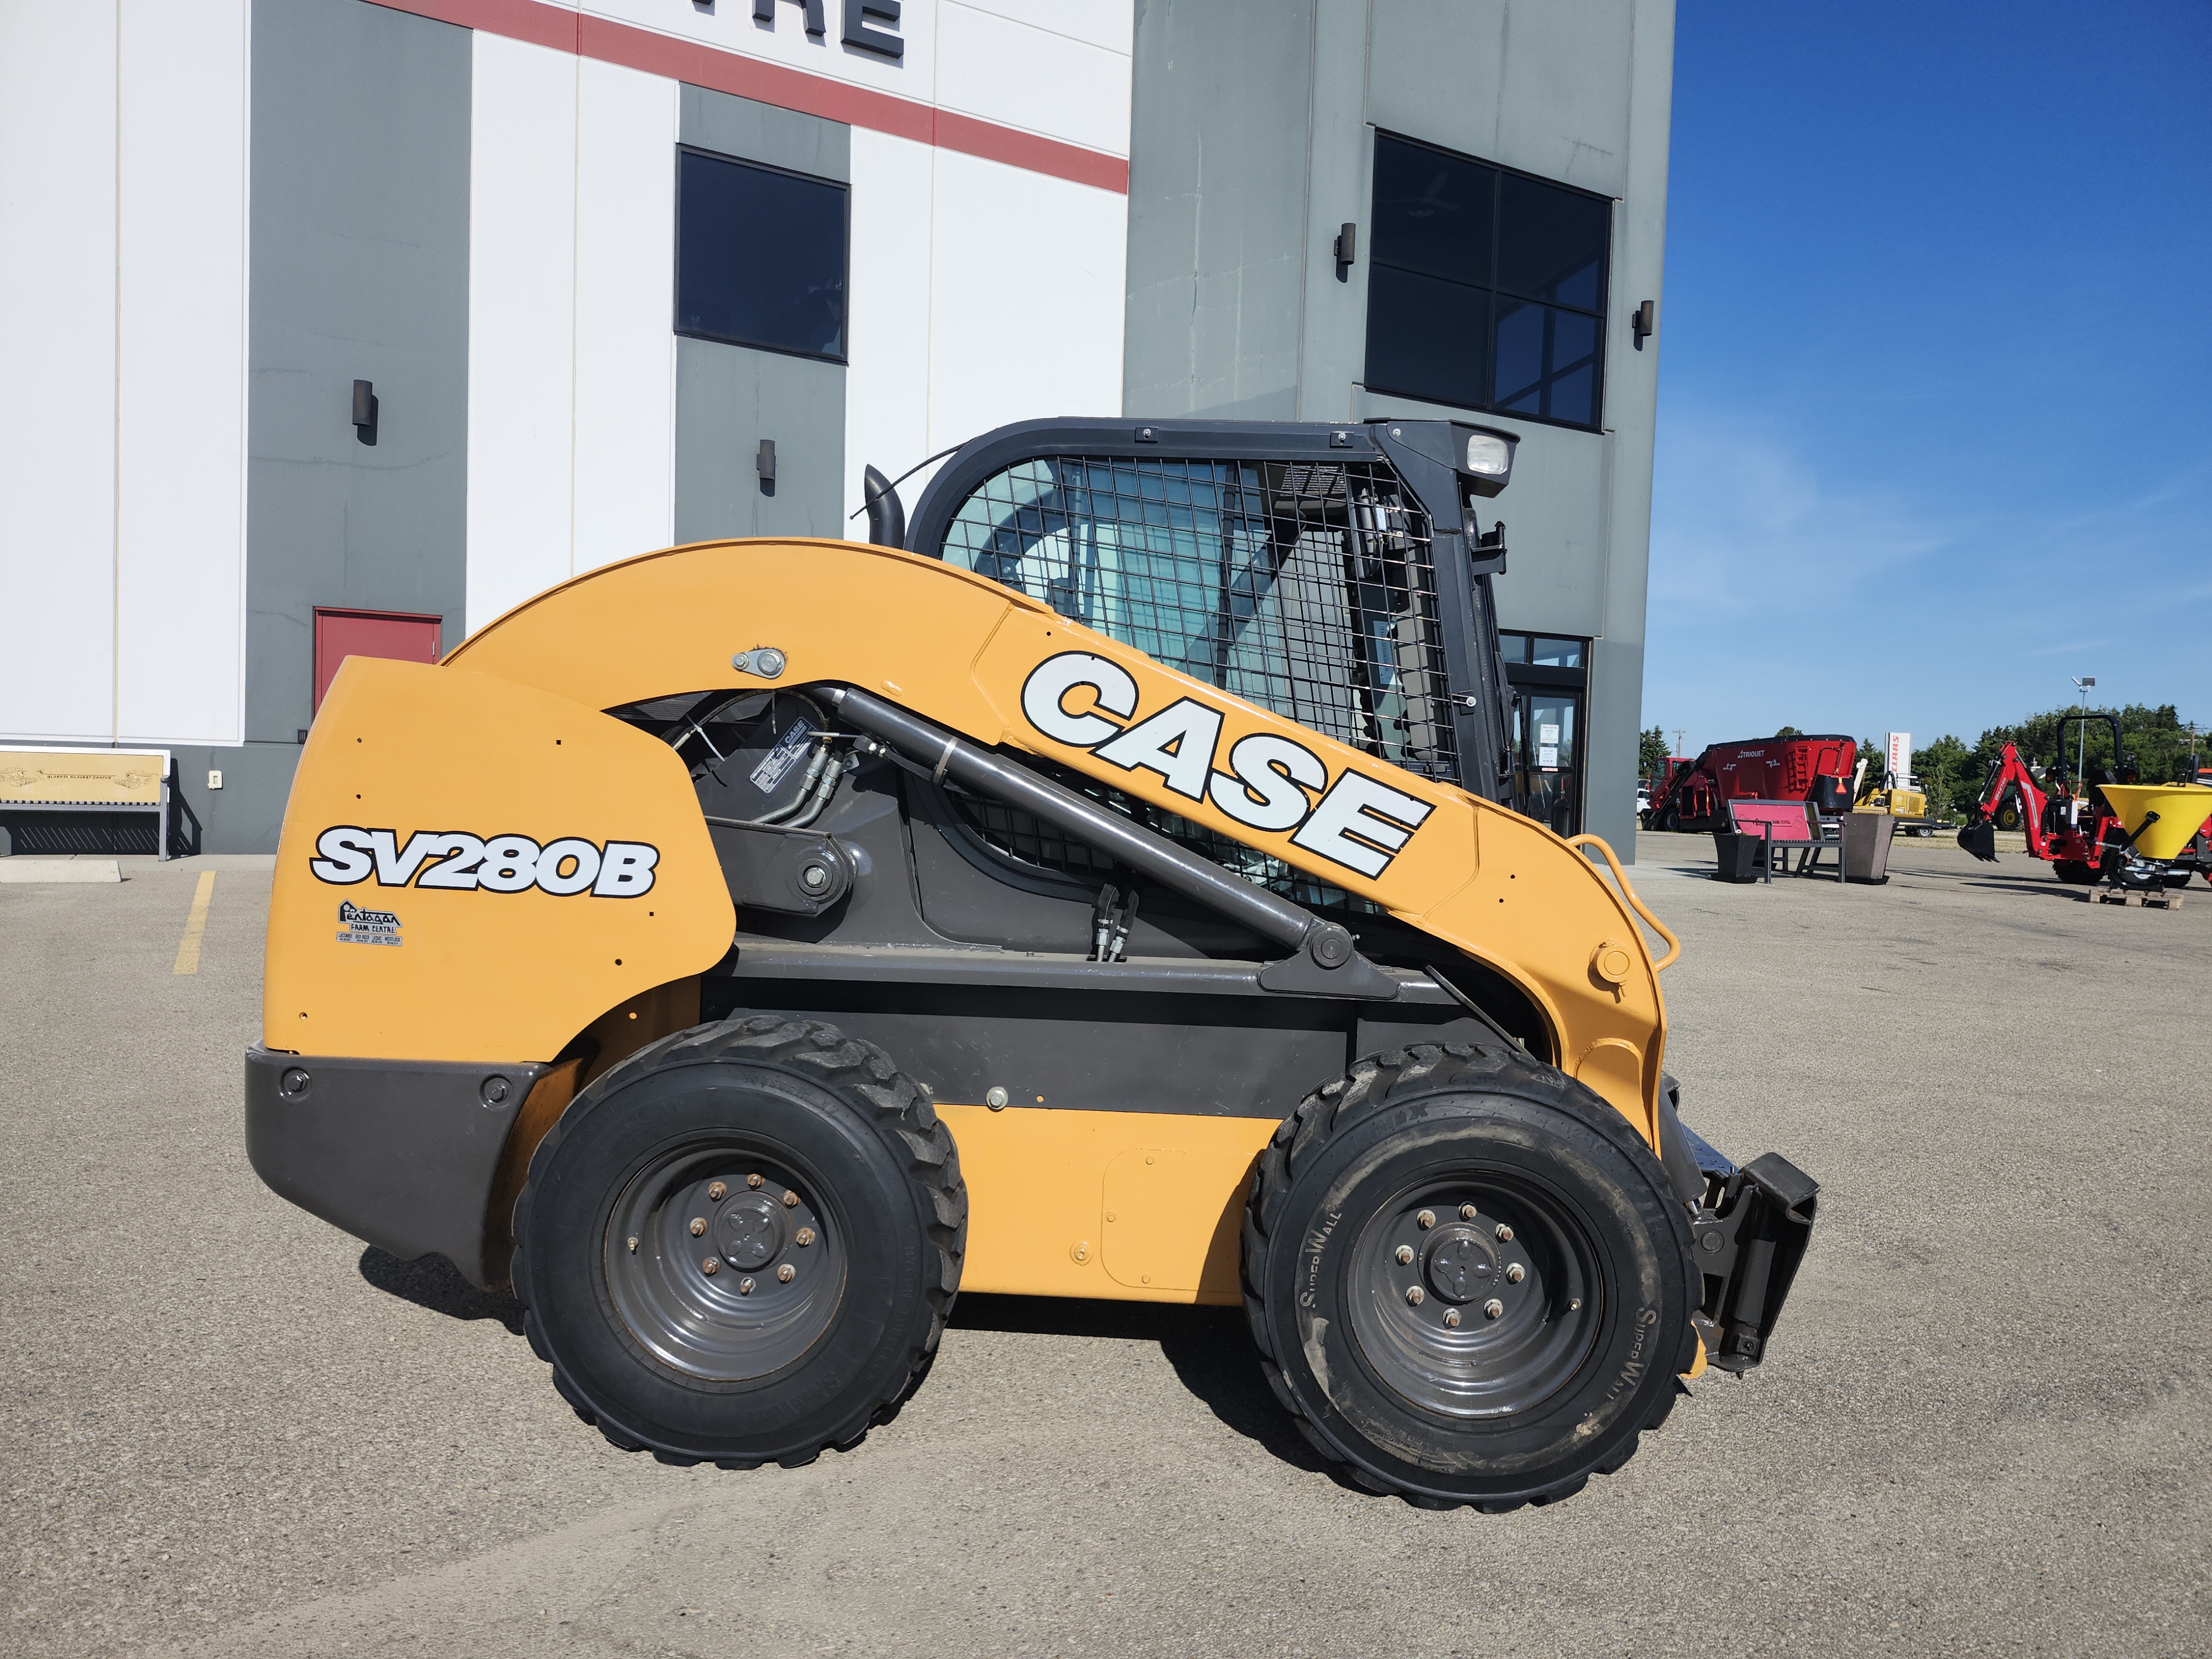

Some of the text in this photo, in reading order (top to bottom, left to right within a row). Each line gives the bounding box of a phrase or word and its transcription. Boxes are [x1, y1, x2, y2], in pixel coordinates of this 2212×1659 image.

[785, 720, 805, 744] CASE
[1020, 650, 1437, 880] CASE
[1743, 750, 1765, 758] TRIOLIET
[309, 825, 660, 898] SV280B
[372, 925, 395, 933] CENTRE
